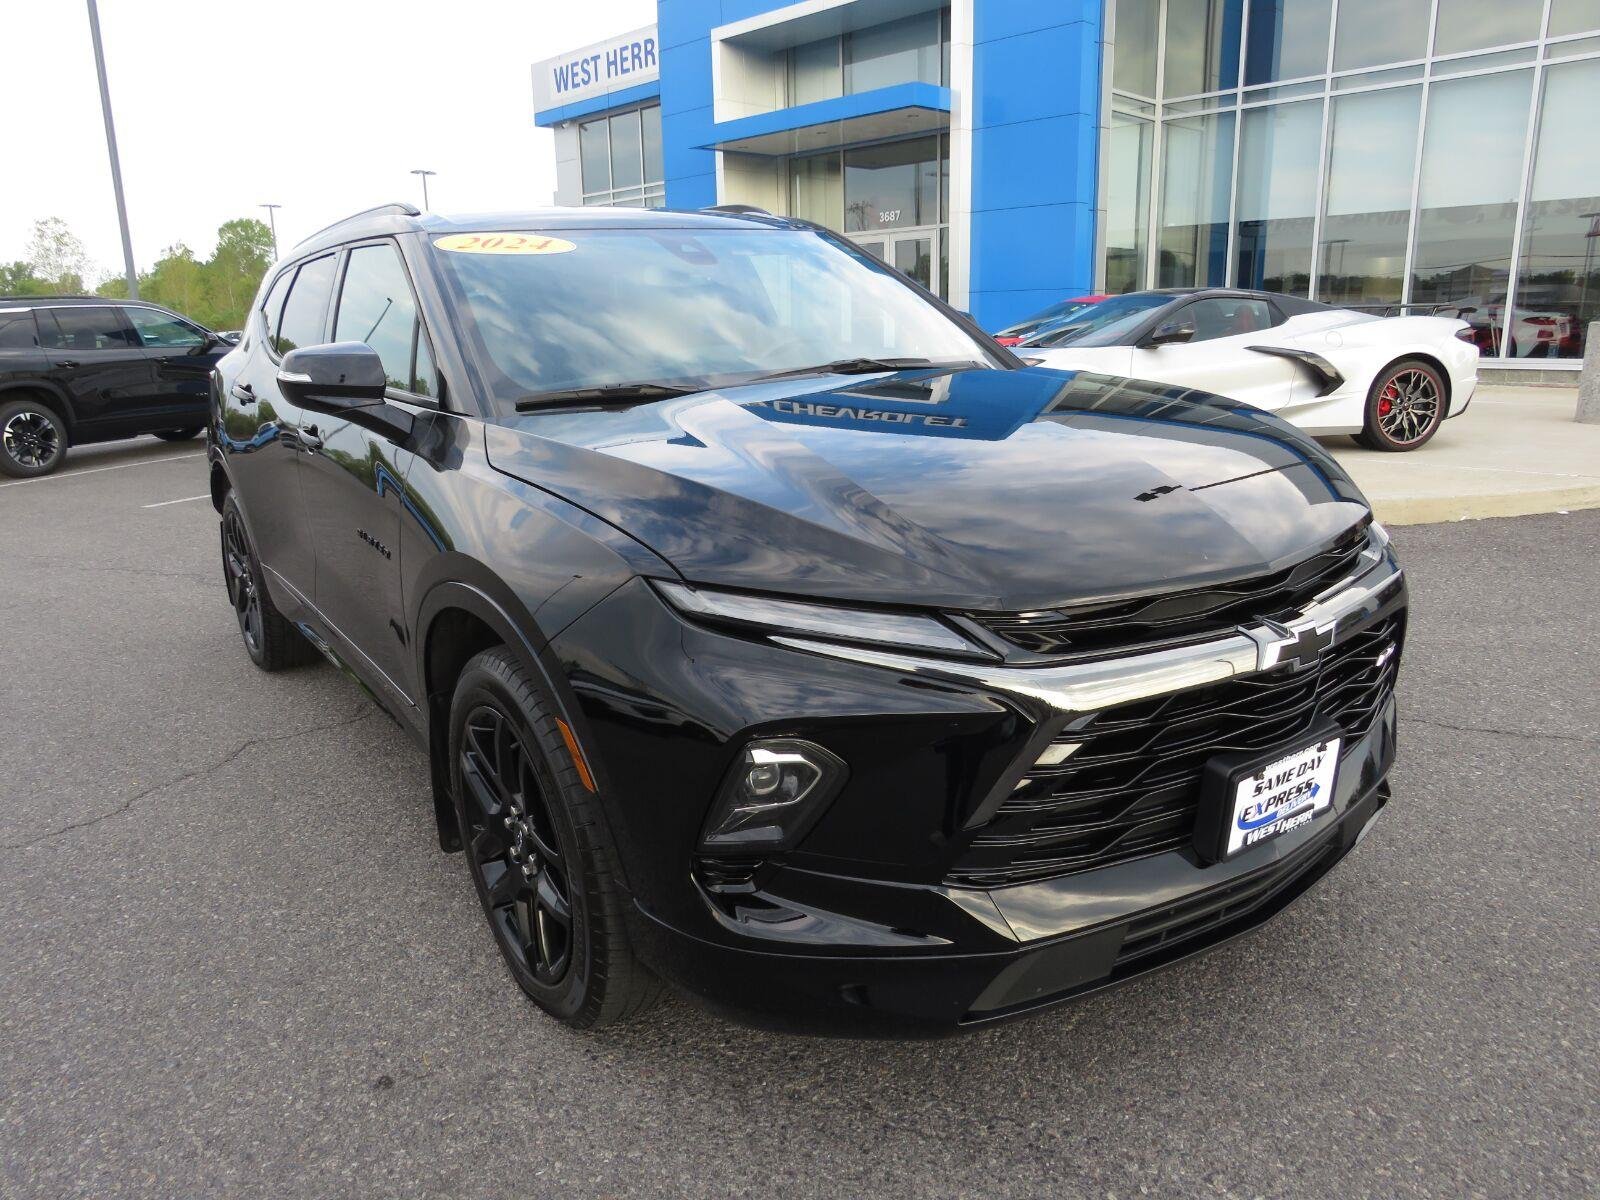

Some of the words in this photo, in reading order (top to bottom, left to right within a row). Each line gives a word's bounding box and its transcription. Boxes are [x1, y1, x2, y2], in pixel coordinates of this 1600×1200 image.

[553, 54, 601, 93] WEST
[606, 38, 656, 79] HERR
[879, 210, 901, 223] 3687
[456, 237, 553, 250] 2024
[1252, 767, 1296, 798] SAME
[1296, 753, 1327, 779] DAY
[1242, 777, 1314, 822] EXPRESS
